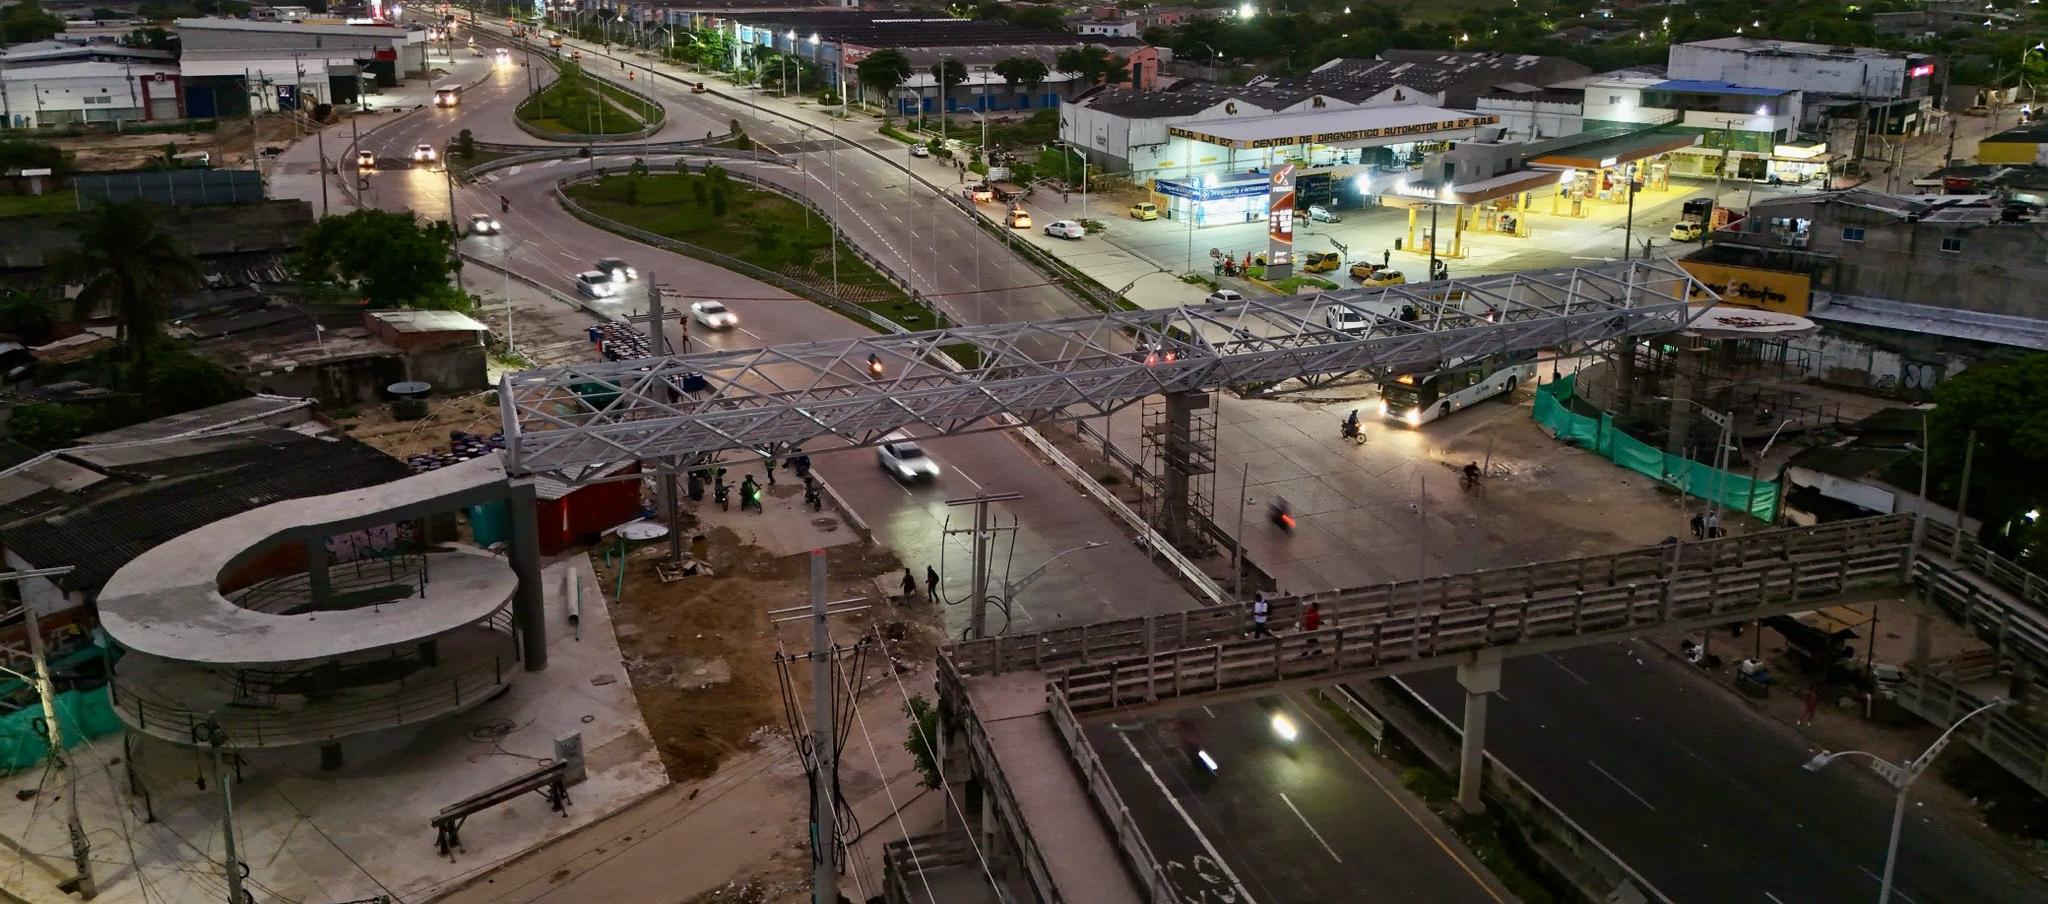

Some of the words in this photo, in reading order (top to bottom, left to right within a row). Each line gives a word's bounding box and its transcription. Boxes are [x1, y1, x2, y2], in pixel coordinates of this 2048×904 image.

[1201, 133, 1216, 145] LA
[1219, 137, 1233, 147] 27
[1252, 136, 1293, 149] CENTRO
[1299, 134, 1312, 144] DE
[1317, 128, 1379, 142] DIAGNOSTICO
[1384, 122, 1438, 136] AUTOMOTOR
[1442, 120, 1453, 129] LA
[1458, 119, 1469, 127] 27
